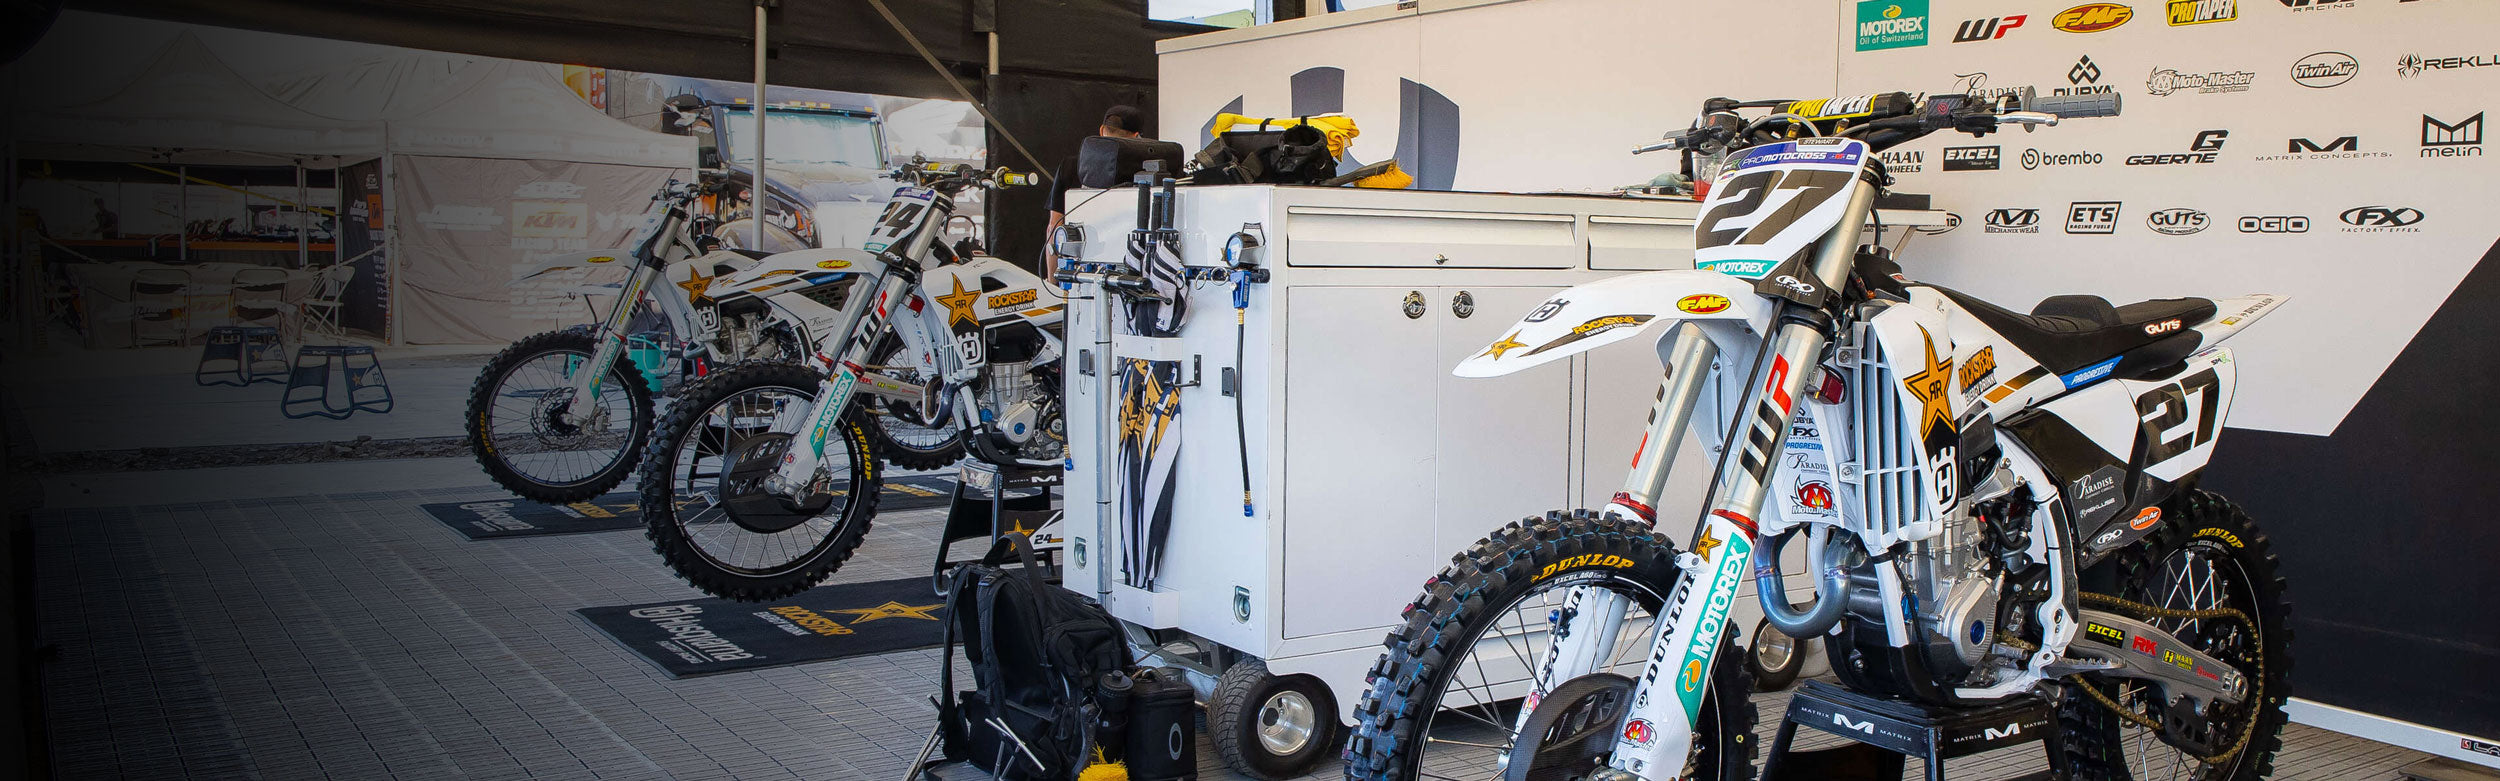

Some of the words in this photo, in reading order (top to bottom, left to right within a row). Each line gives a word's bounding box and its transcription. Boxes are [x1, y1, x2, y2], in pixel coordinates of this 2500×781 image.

[2293, 3, 2355, 13] RACING
[2053, 6, 2133, 29] FMF
[1860, 17, 1924, 37] MOTOREX
[1952, 15, 2028, 43] WP
[1860, 36, 1870, 45] Oil
[1872, 35, 1879, 44] of
[1881, 32, 1924, 43] Switzerland
[2171, 71, 2255, 89] Moto-Master
[1741, 152, 1828, 167] PROMOTOCROSS
[1881, 151, 1925, 164] HAAN
[1944, 148, 1999, 161] EXCEL
[2043, 150, 2103, 166] brembo
[2420, 145, 2482, 158] melin
[1886, 164, 1922, 174] WHEELS
[1695, 169, 1853, 250] 27
[2072, 206, 2116, 222] ETS
[2150, 209, 2208, 226] GUTS
[1984, 224, 2019, 234] MECHANIX
[2019, 224, 2040, 233] WEAR
[2238, 215, 2310, 233] OGIO
[1714, 261, 1765, 273] MOTOREX
[988, 288, 1038, 309] ROCKSTAR
[1679, 296, 1729, 311] FMF
[994, 304, 1016, 315] ENERGY
[1015, 302, 1036, 311] DRINK
[859, 289, 888, 352] WP
[1572, 316, 1635, 335] ROCKSTAR
[2144, 319, 2181, 335] GUTS
[1585, 324, 1613, 337] ENERGY
[1958, 345, 1997, 395] ROCKSTAR
[2070, 361, 2115, 386] PROGRESSIVE
[820, 376, 852, 428] MOTOREX
[1739, 353, 1792, 488] WP
[2136, 367, 2220, 463] 27
[854, 426, 873, 481] DUNLOP
[2072, 474, 2114, 499] PARADISE
[2132, 515, 2149, 527] Twin
[2148, 510, 2159, 520] Air
[1034, 533, 1052, 545] 24
[2198, 527, 2245, 548] DUNLOP
[1538, 553, 1635, 580] DUNLOP
[1554, 574, 1579, 585] EXCEL
[1690, 542, 1747, 660] MOTOREX
[768, 606, 855, 636] ROCKSTAR
[2087, 623, 2124, 641] EXCEL
[2132, 634, 2158, 656] RK
[2175, 653, 2194, 666] HAAN
[1801, 706, 1830, 719] MATRIX
[1879, 729, 1913, 742] MATRIX
[1953, 733, 1982, 743] MATRIX
[2023, 719, 2049, 729] MATRIX
